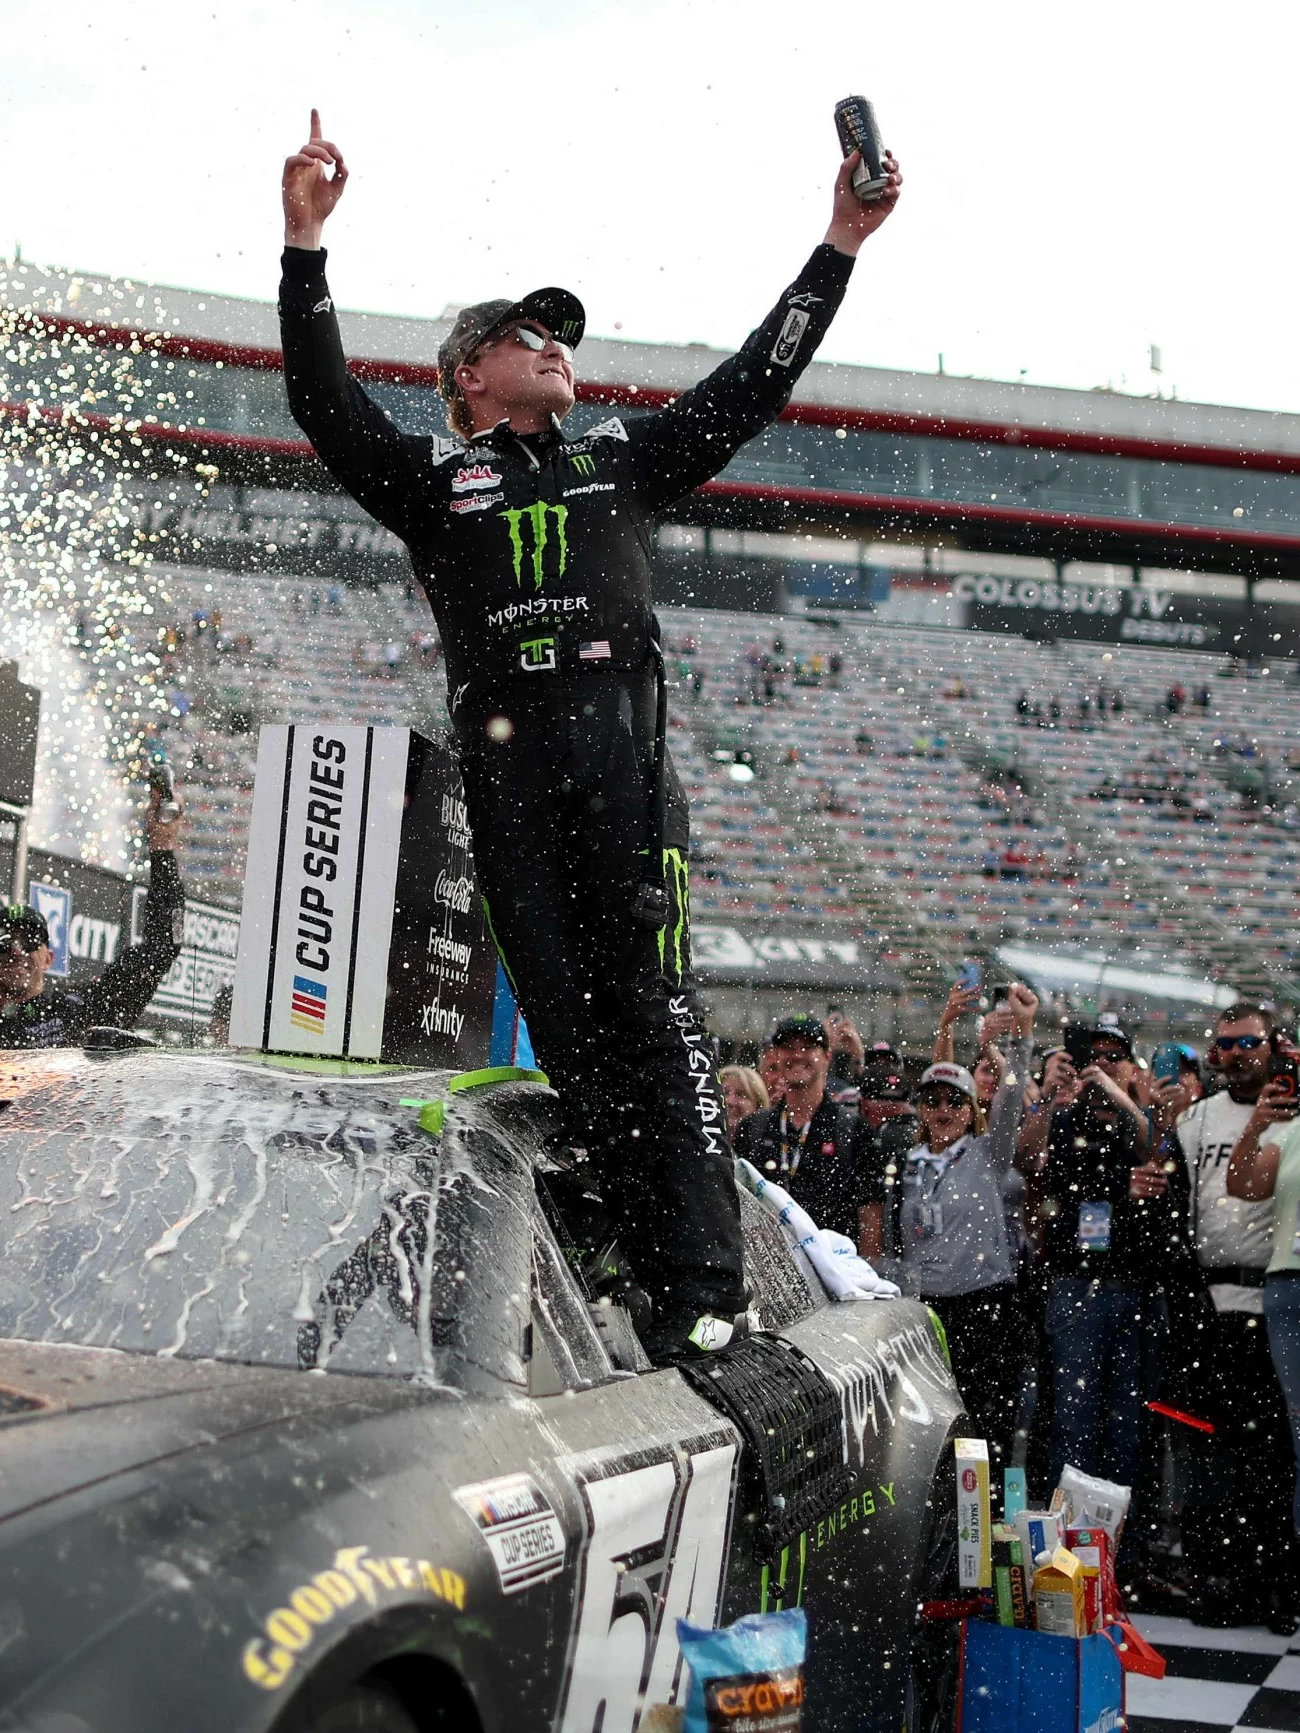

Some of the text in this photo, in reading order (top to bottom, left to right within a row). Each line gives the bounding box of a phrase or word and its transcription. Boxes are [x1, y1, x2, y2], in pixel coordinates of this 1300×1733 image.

[451, 492, 504, 511] SportClips
[562, 483, 615, 497] GOODYEAR
[488, 596, 589, 628] MONSTER
[952, 574, 1172, 618] COLOSSUS TV
[502, 615, 574, 634] ENERGY
[295, 735, 347, 972] CUP SERIES
[447, 829, 470, 849] LIGHT
[69, 913, 121, 964] CITY
[428, 927, 472, 971] Freeway
[425, 962, 470, 985] INSURANCE
[421, 997, 465, 1043] xfinity
[816, 1482, 897, 1549] ENERGY
[970, 1503, 980, 1544] SNACK PIES
[501, 1522, 555, 1564] CUP SERIES
[243, 1545, 467, 1690] GOODYEAR
